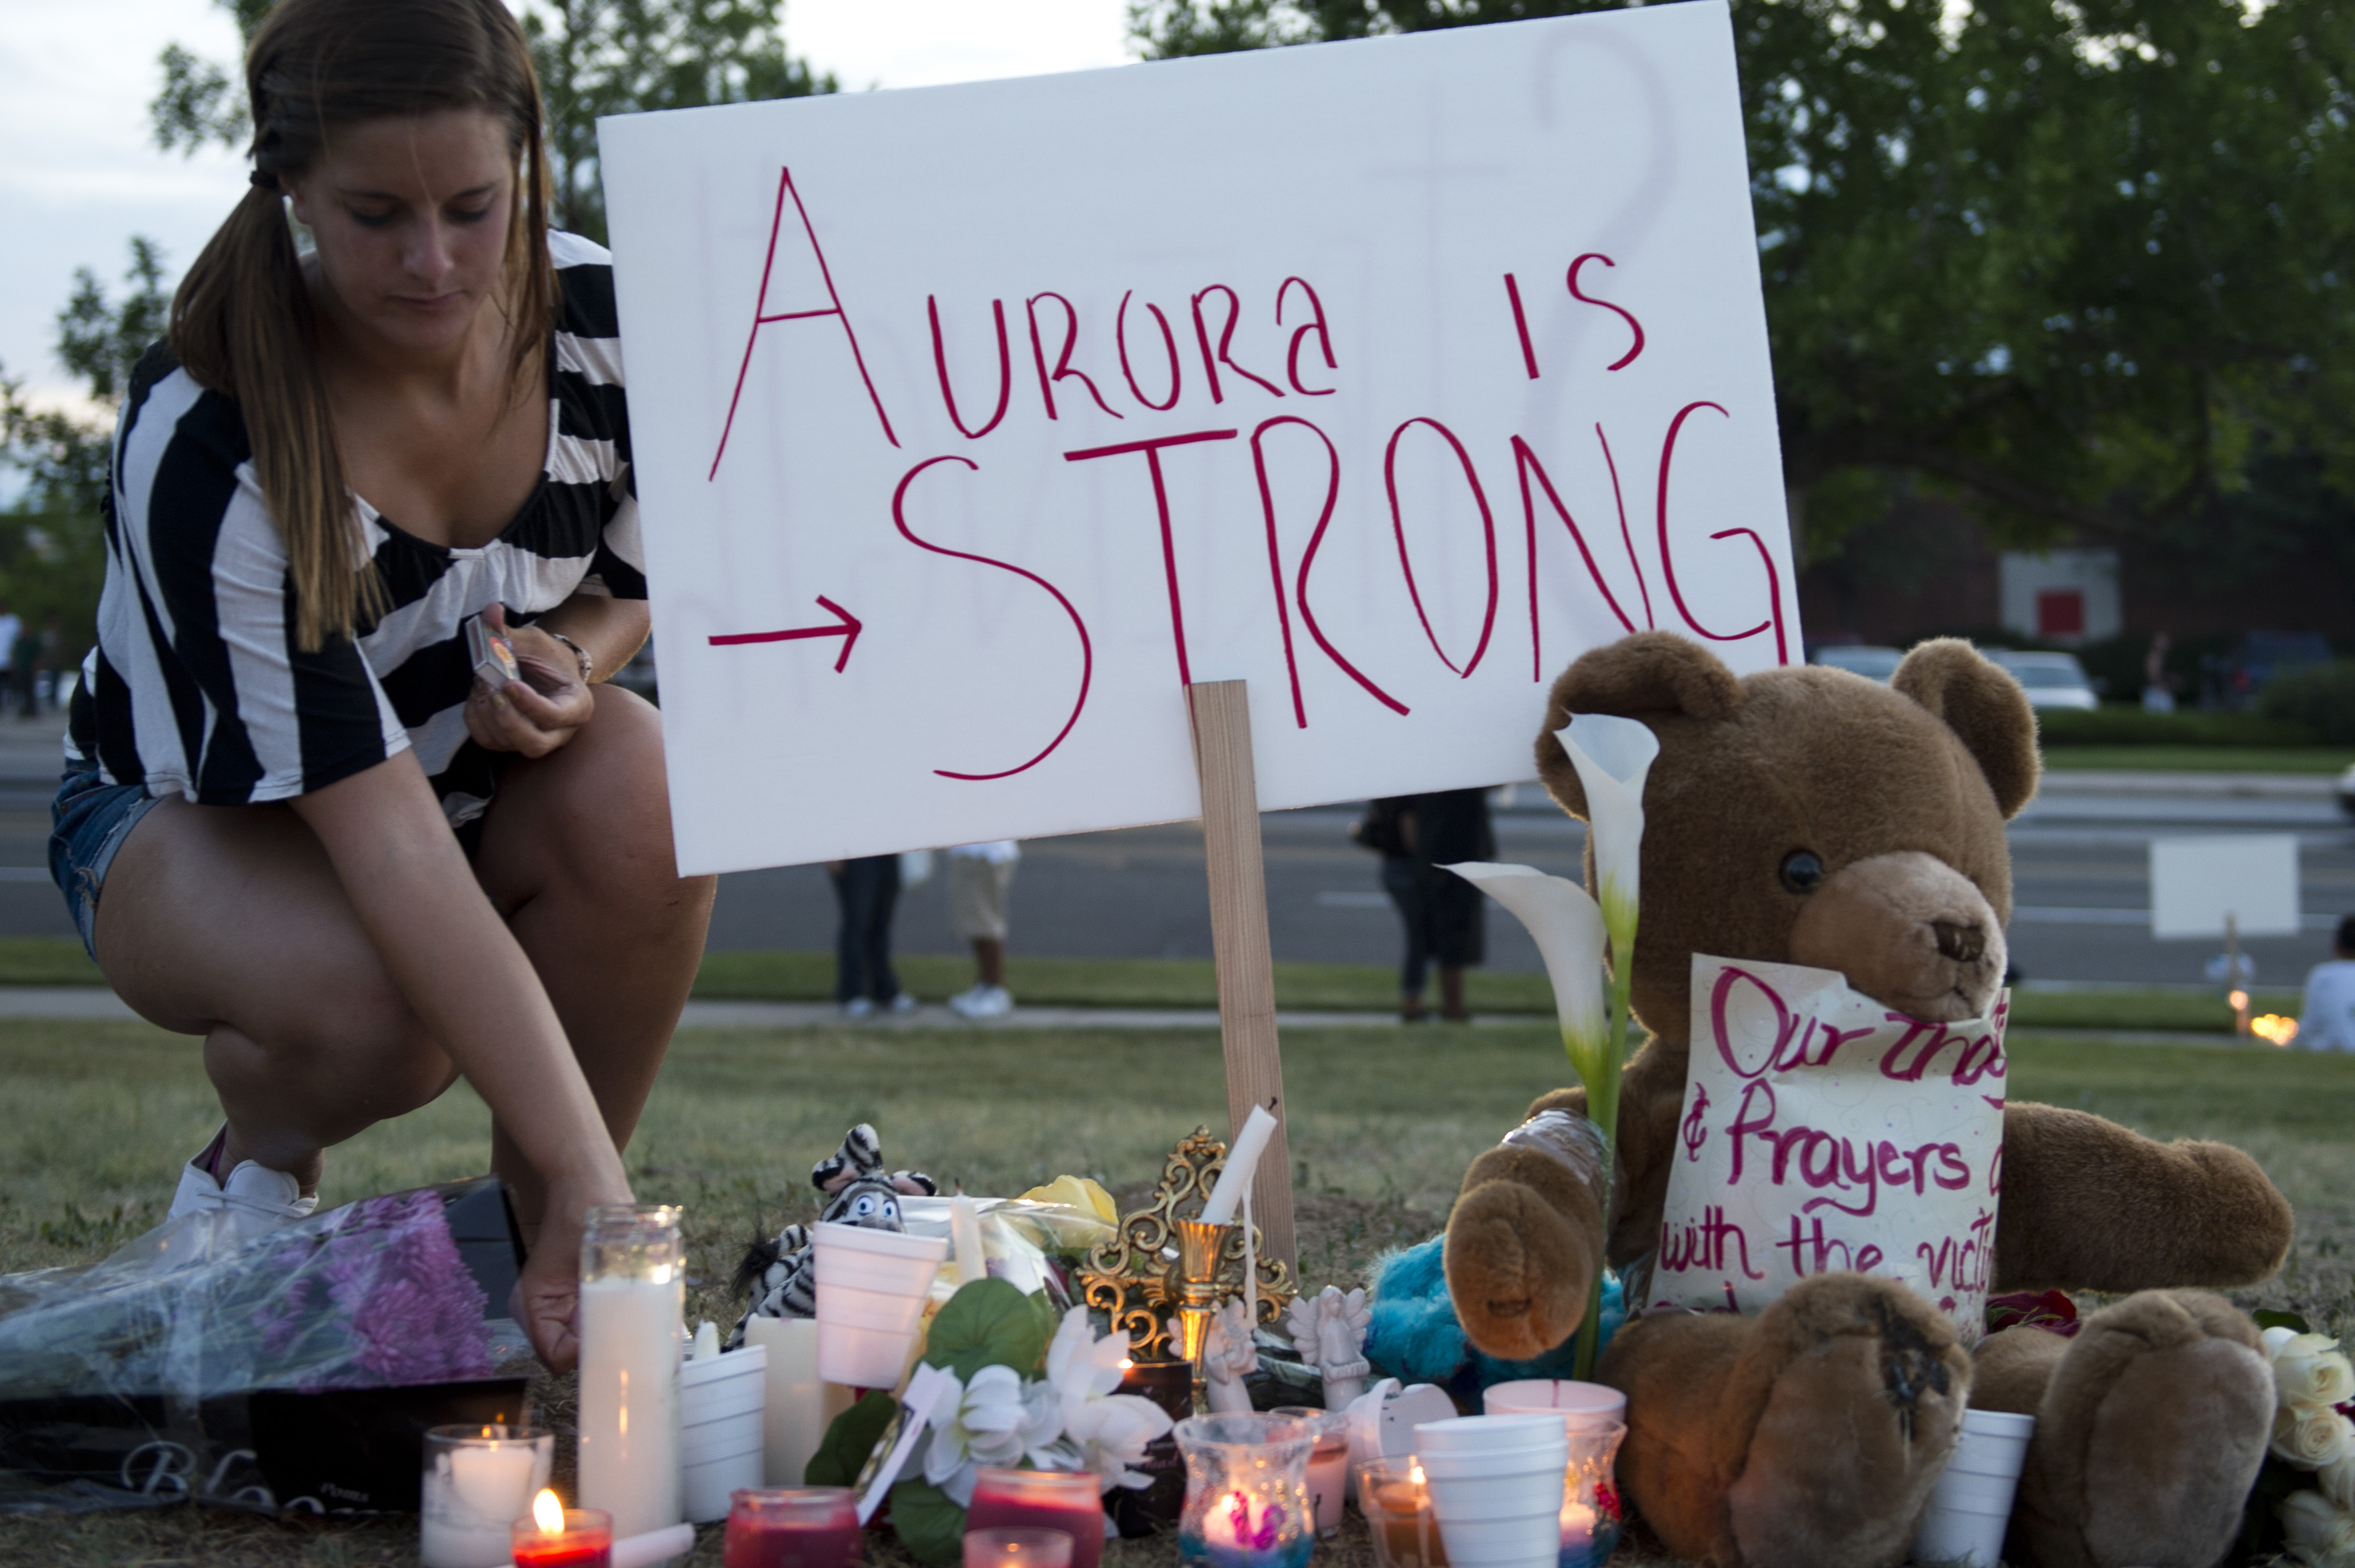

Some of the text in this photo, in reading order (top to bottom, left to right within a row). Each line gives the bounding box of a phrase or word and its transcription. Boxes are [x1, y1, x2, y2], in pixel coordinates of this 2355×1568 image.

[891, 401, 1789, 781] STRONG
[1710, 965, 1876, 1079] Our
[1724, 1077, 1971, 1217] Prayers
[1660, 1205, 1765, 1280] with
[1775, 1213, 1884, 1278] the
